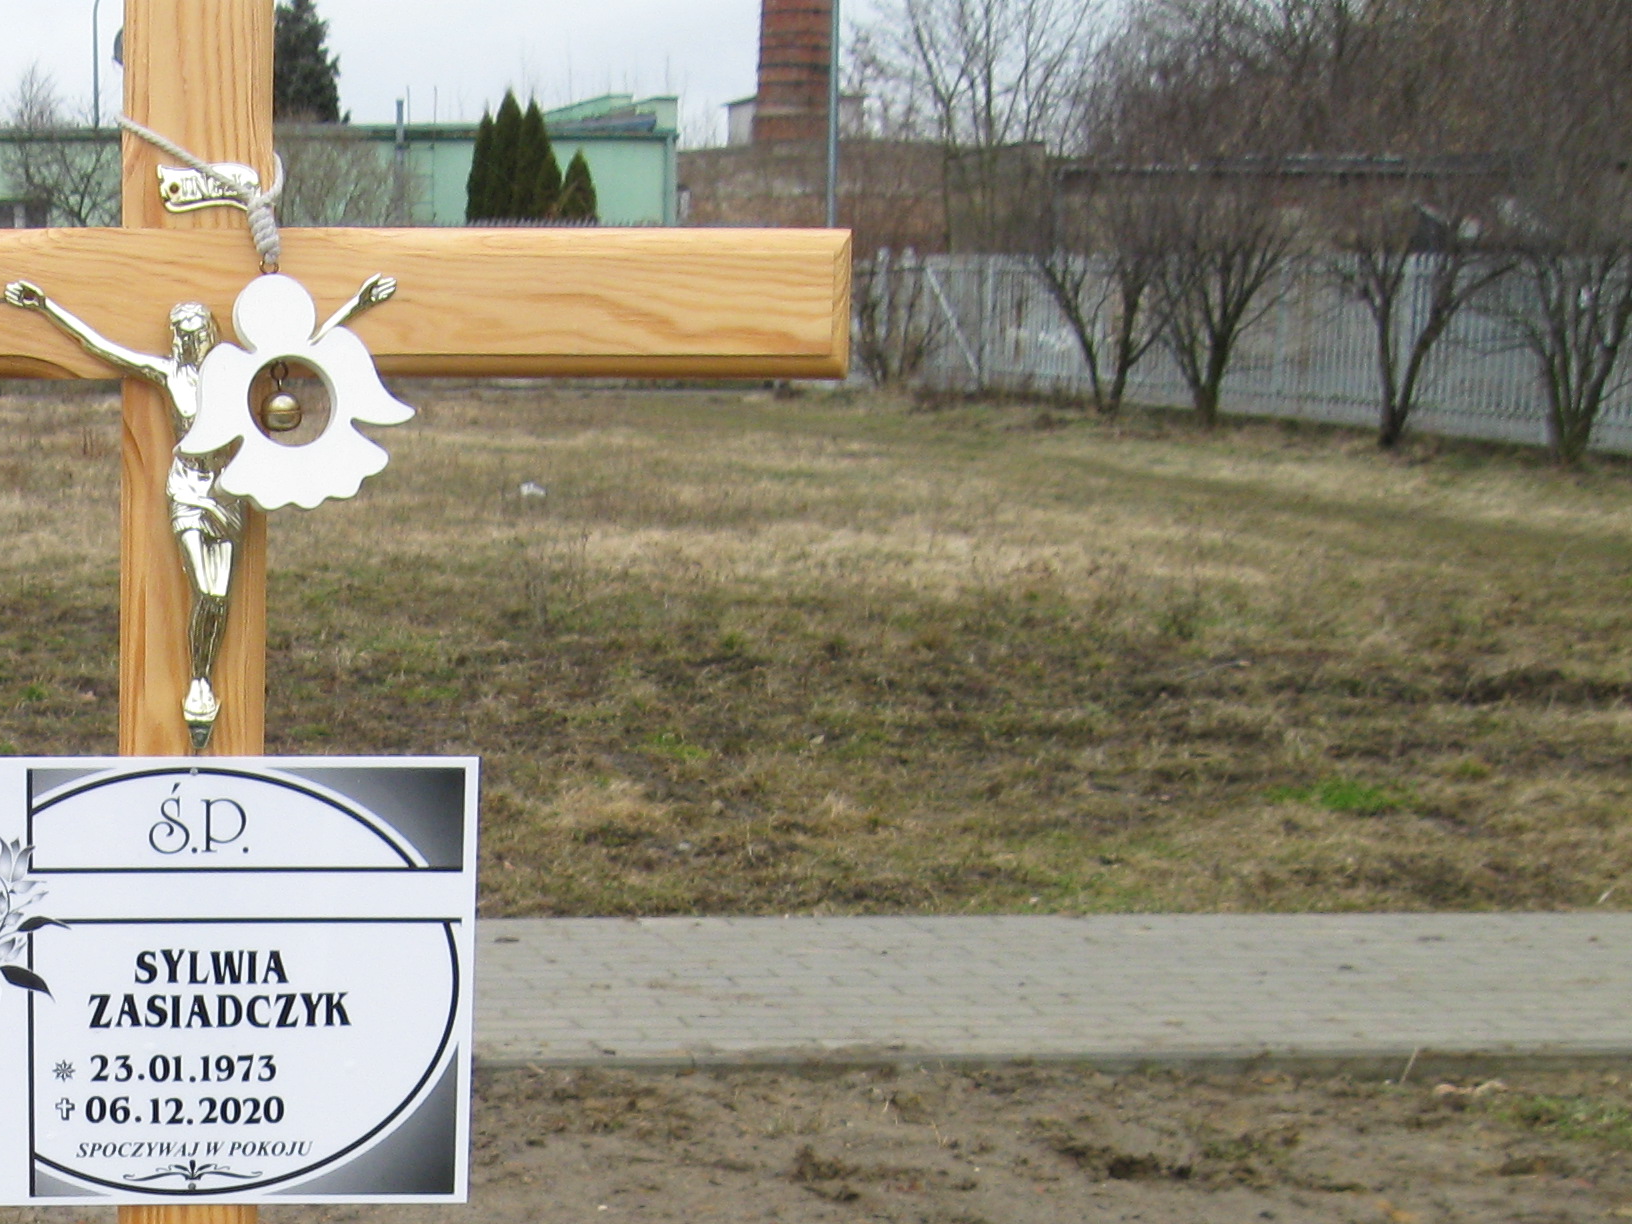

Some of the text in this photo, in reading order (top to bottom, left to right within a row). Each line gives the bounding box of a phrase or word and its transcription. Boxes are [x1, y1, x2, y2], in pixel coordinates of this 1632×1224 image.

[148, 782, 250, 855] Ś.P.
[134, 948, 289, 985] SYLWIA
[88, 991, 352, 1029] ZASIADCZYK
[90, 1053, 277, 1083] 23.01.1973
[85, 1095, 285, 1126] 06.12.2020
[76, 1140, 313, 1159] SPOCZYWAJ W POKOJU
